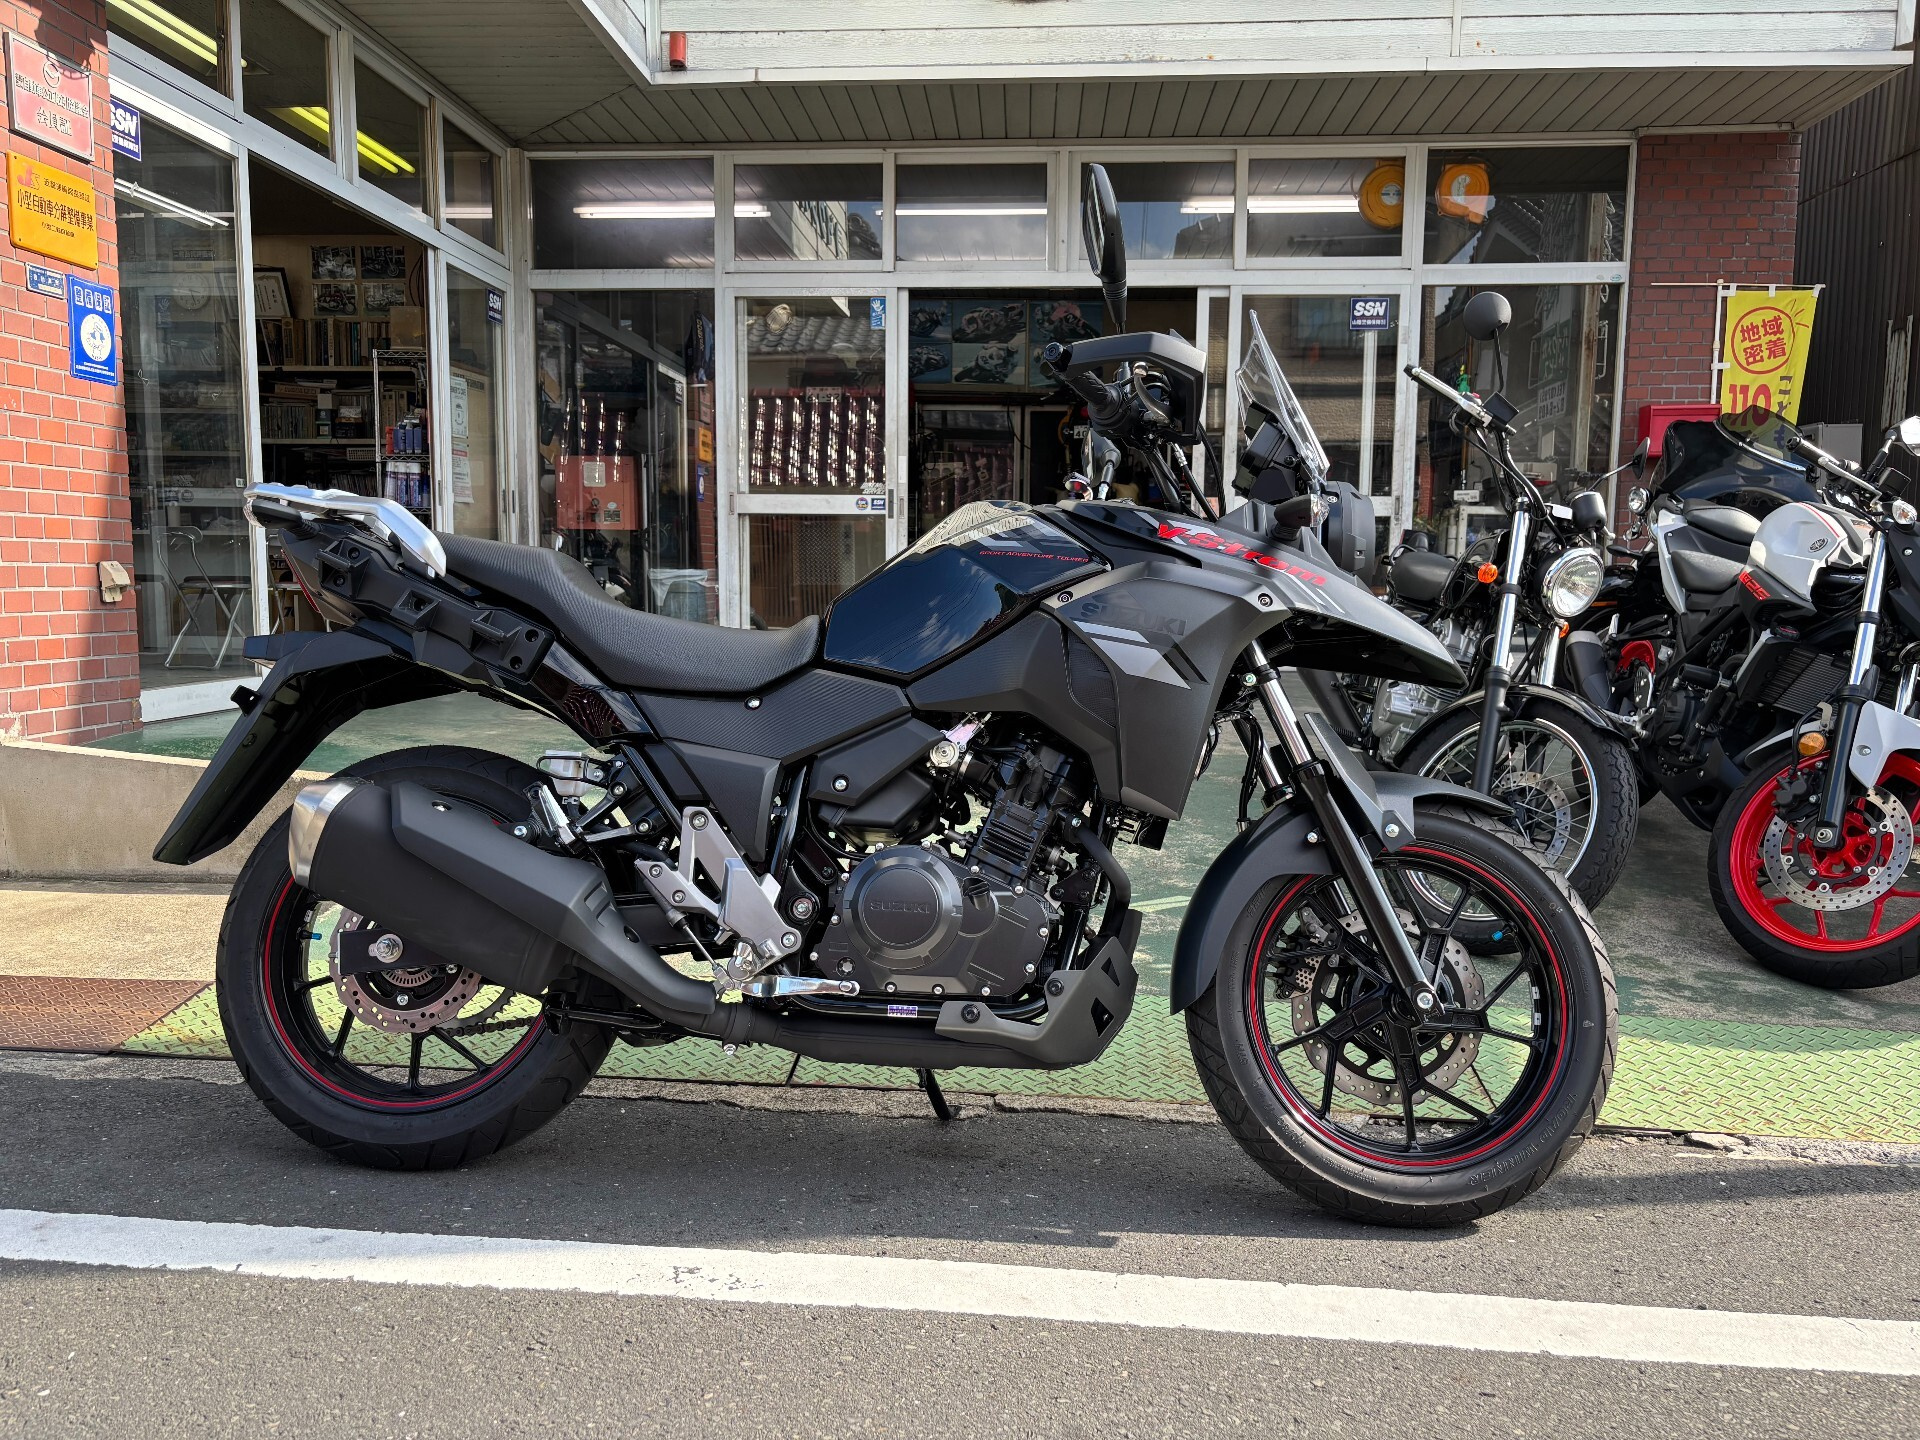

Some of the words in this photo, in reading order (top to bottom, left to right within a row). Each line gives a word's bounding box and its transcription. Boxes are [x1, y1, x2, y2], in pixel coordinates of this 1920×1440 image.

[17, 188, 95, 233] 小型自動車分解整備事業
[1353, 301, 1387, 317] SSN
[1739, 315, 1785, 344] 地域
[1743, 337, 1787, 367] 密着
[1728, 384, 1772, 427] 110
[1006, 551, 1054, 560] ADVENTURE
[1056, 555, 1090, 563] TOURER
[1157, 523, 1328, 587] V-Strom
[1080, 602, 1188, 637] SUZUKI
[870, 901, 931, 914] SUZUKI
